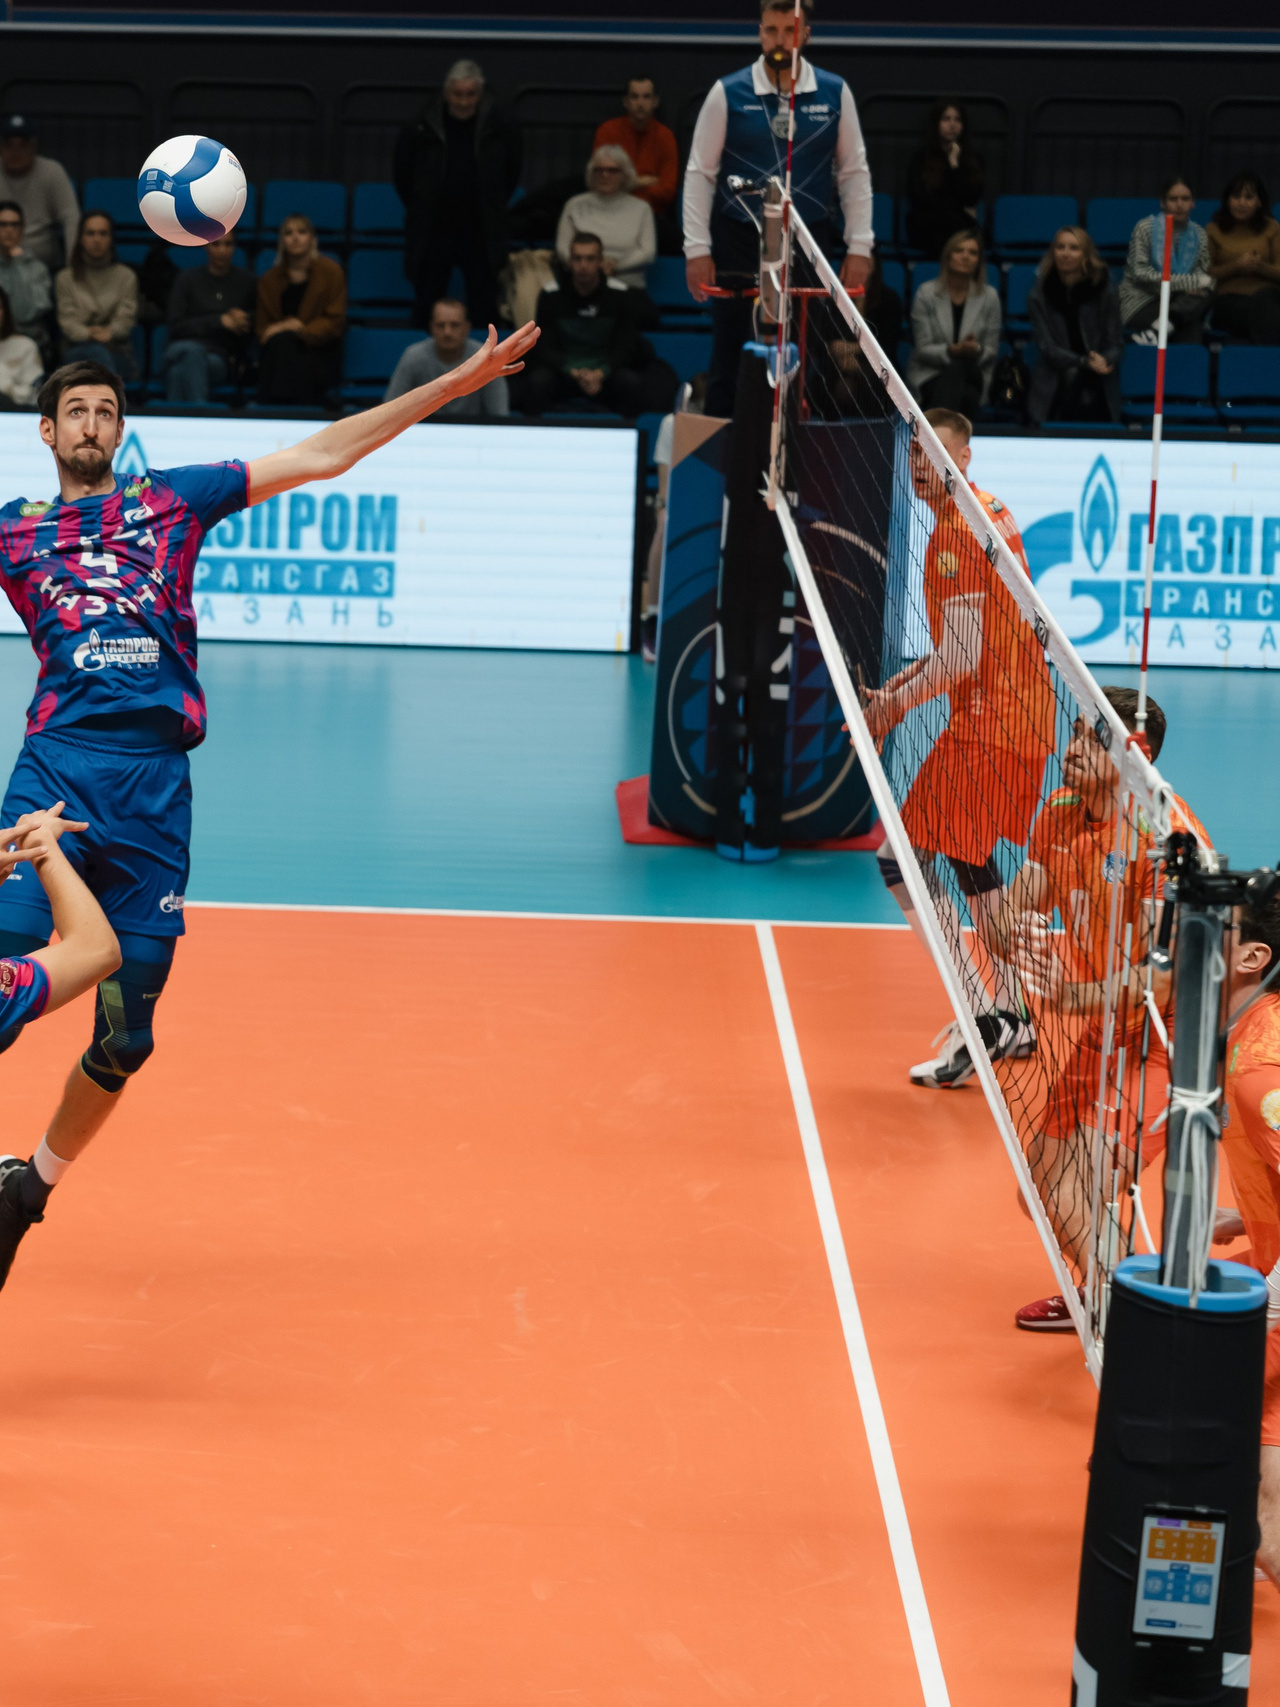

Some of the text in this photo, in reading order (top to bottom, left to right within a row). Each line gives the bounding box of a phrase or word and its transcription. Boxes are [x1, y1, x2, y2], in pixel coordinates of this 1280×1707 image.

[204, 493, 398, 553] ЗПРОМ
[193, 561, 390, 594] РАНСГАЗ
[198, 598, 393, 627] АЗАНЬ
[103, 637, 160, 653] ГАЗПРОМ
